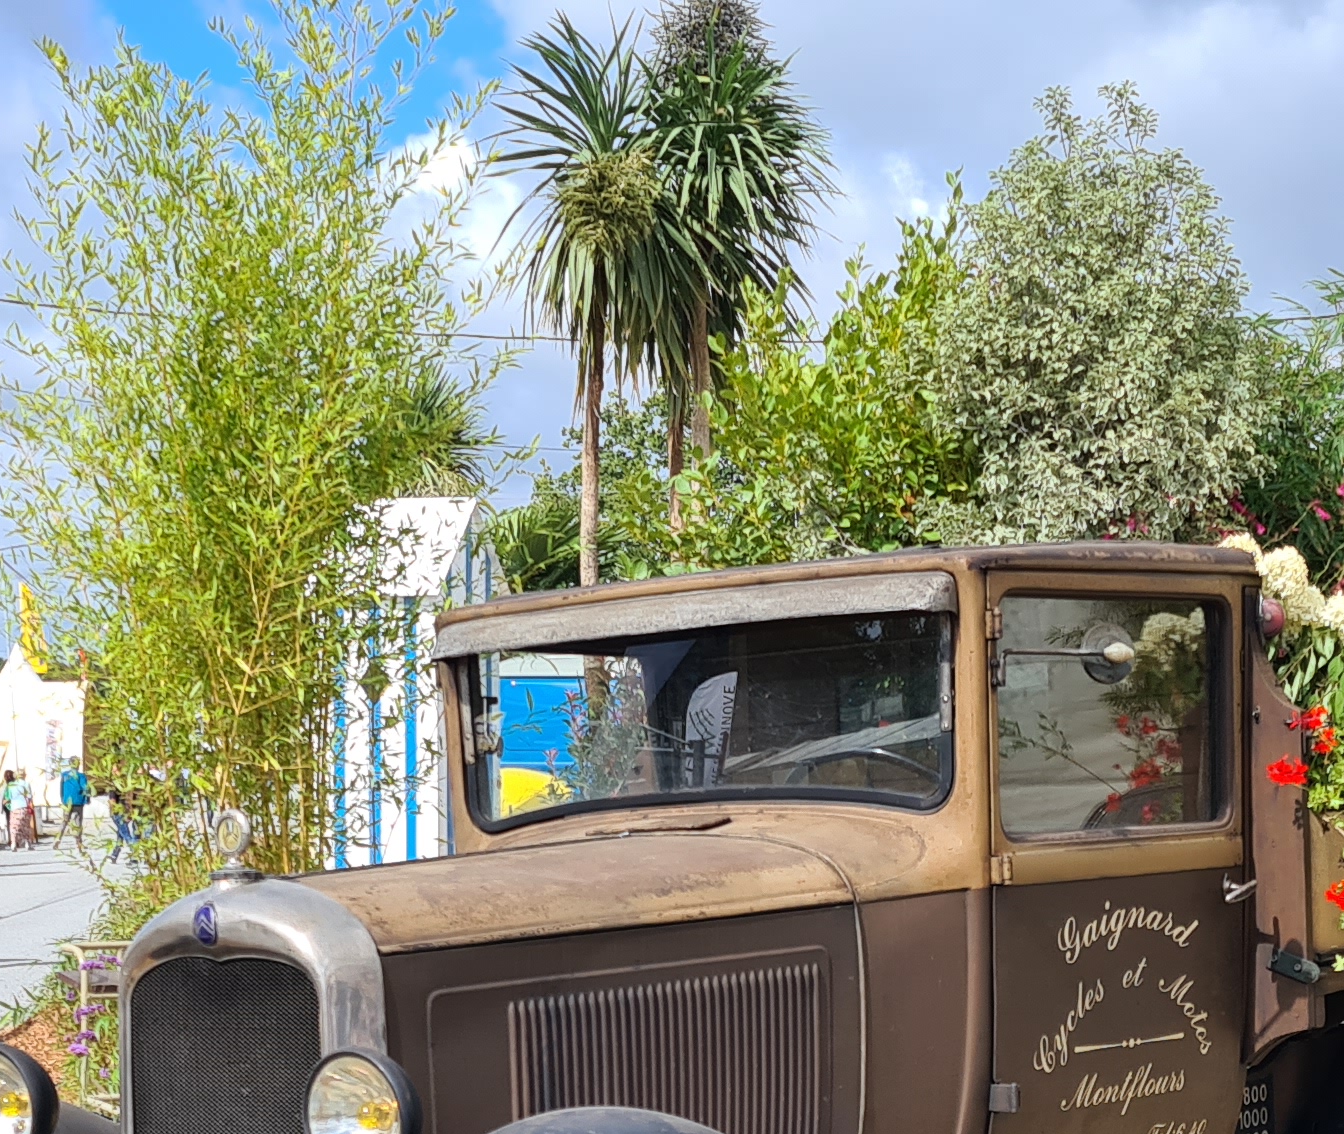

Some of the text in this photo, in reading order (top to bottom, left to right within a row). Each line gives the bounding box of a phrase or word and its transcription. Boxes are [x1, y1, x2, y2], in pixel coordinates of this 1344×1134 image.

[1057, 900, 1199, 964] Gaignard
[1033, 957, 1212, 1074] Cycles et Motos
[1060, 1063, 1185, 1116] Montflours
[1243, 1084, 1268, 1106] 800
[1239, 1107, 1269, 1130] 1000
